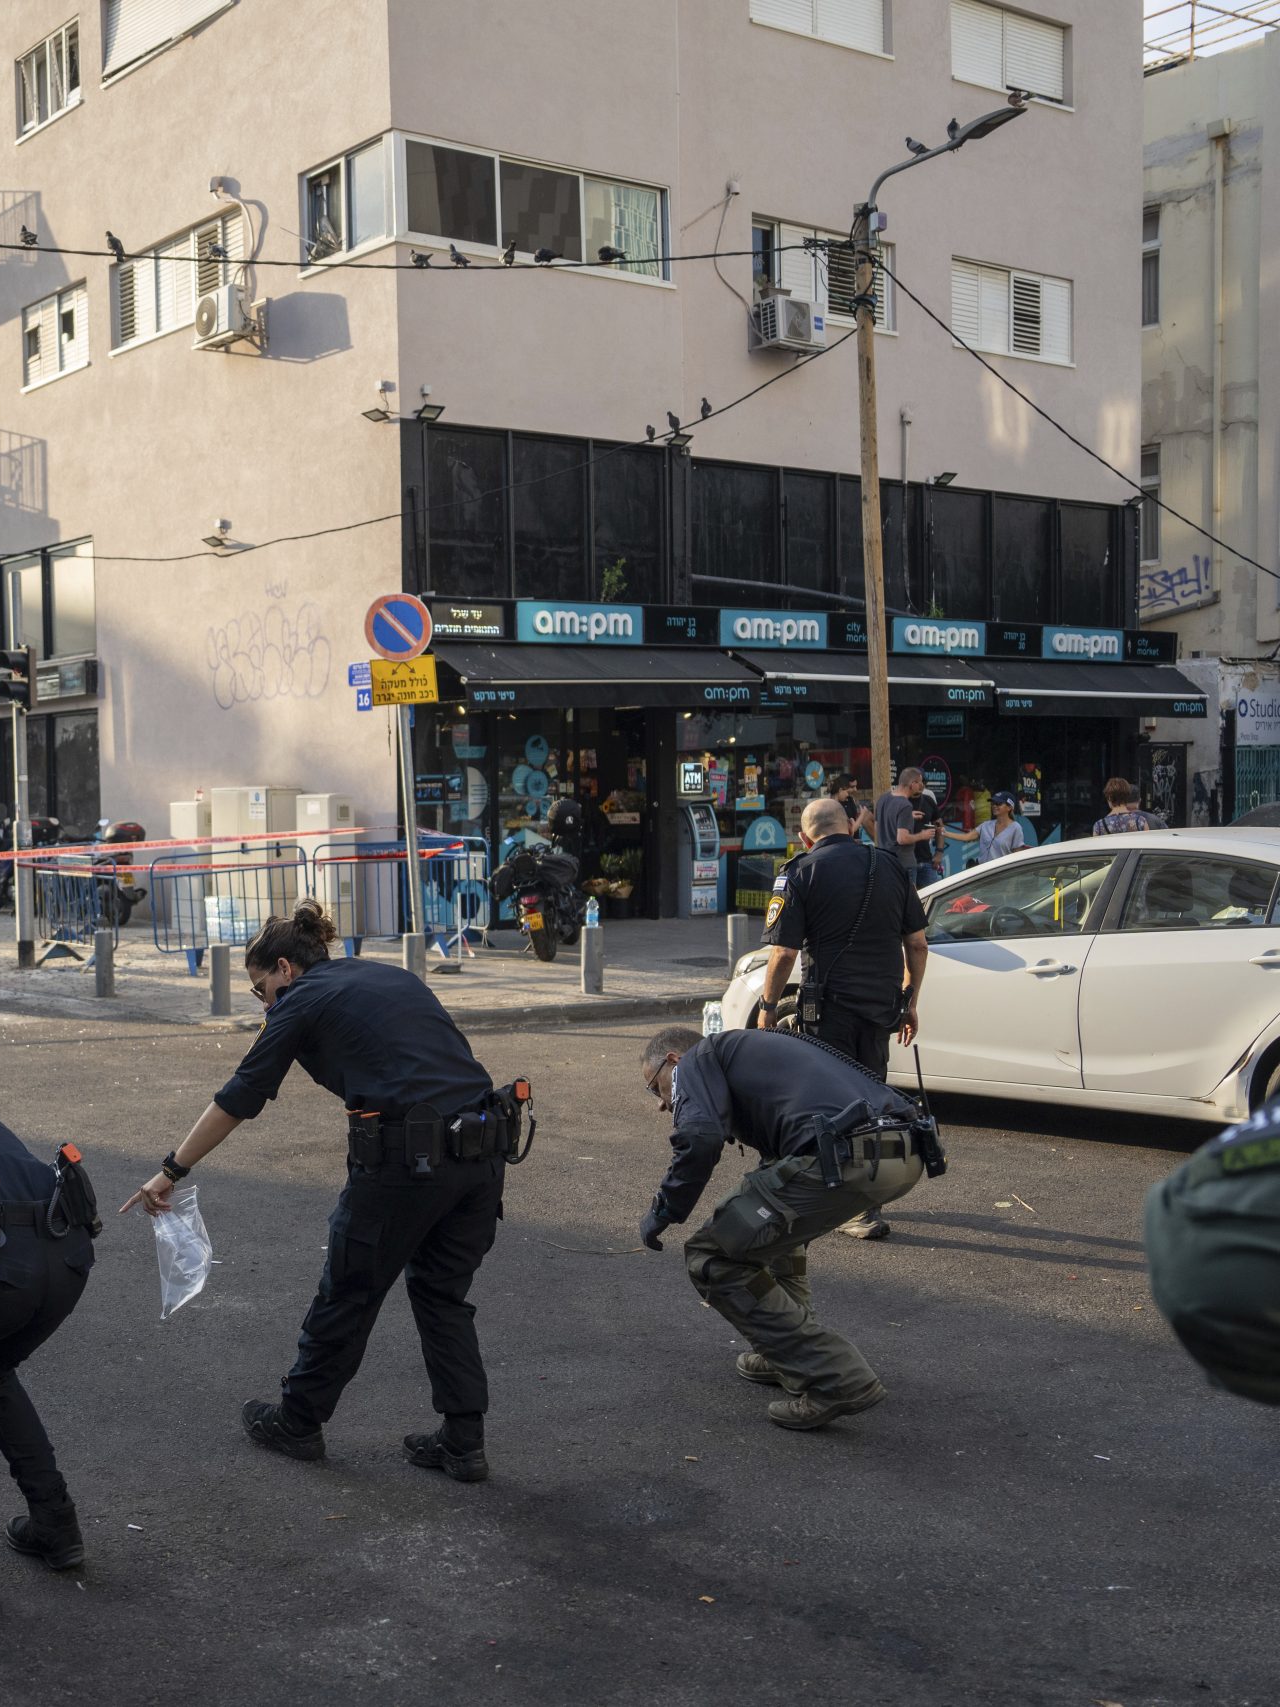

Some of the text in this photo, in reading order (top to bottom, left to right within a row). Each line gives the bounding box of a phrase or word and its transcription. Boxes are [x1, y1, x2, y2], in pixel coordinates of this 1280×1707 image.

[533, 610, 633, 641] am:pm
[667, 616, 696, 629] בן יהודה
[846, 622, 861, 633] city
[686, 628, 696, 638] 30
[733, 617, 820, 646] am:pm
[904, 624, 979, 652] am:pm
[846, 634, 868, 643] mark
[1052, 632, 1119, 658] am:pm
[1137, 638, 1149, 648] city
[1137, 648, 1159, 656] market
[375, 689, 435, 703] רכב חונה יגרר
[473, 690, 515, 701] סיטי מרקט
[704, 687, 750, 702] am:pm
[774, 685, 807, 695] סיטי מרקט
[947, 688, 985, 702] am:pm
[358, 692, 370, 706] 16
[1174, 701, 1204, 714] am:pm
[684, 772, 701, 784] ATM
[1022, 776, 1037, 788] 10%
